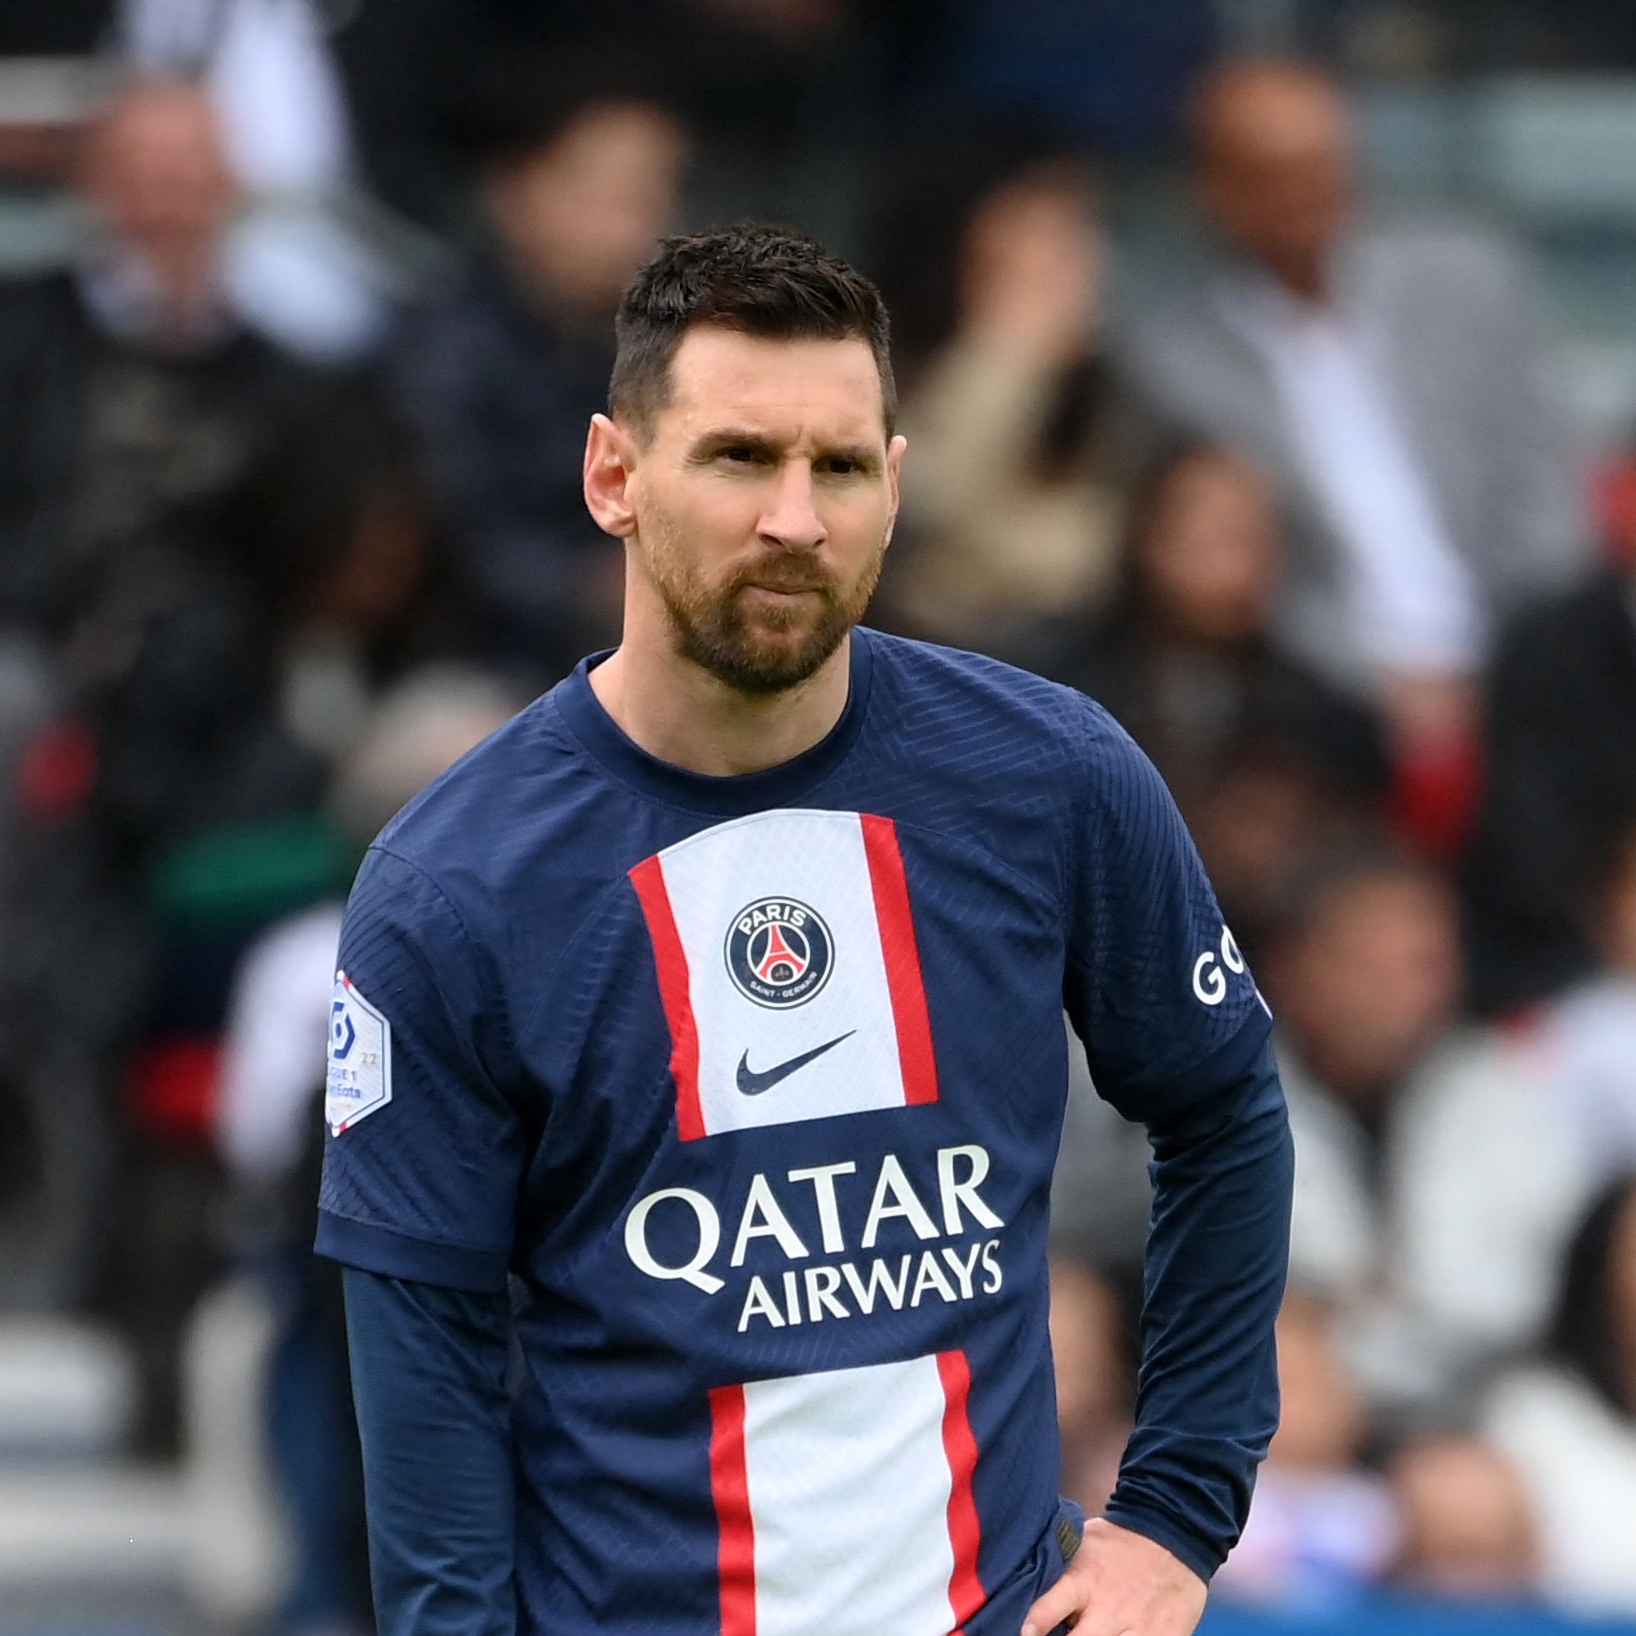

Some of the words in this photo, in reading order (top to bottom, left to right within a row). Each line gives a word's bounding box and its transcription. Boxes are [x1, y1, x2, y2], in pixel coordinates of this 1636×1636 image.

[737, 904, 807, 936] PARIS
[624, 1144, 1005, 1296] QATAR
[737, 1239, 1003, 1333] AIRWAYS
